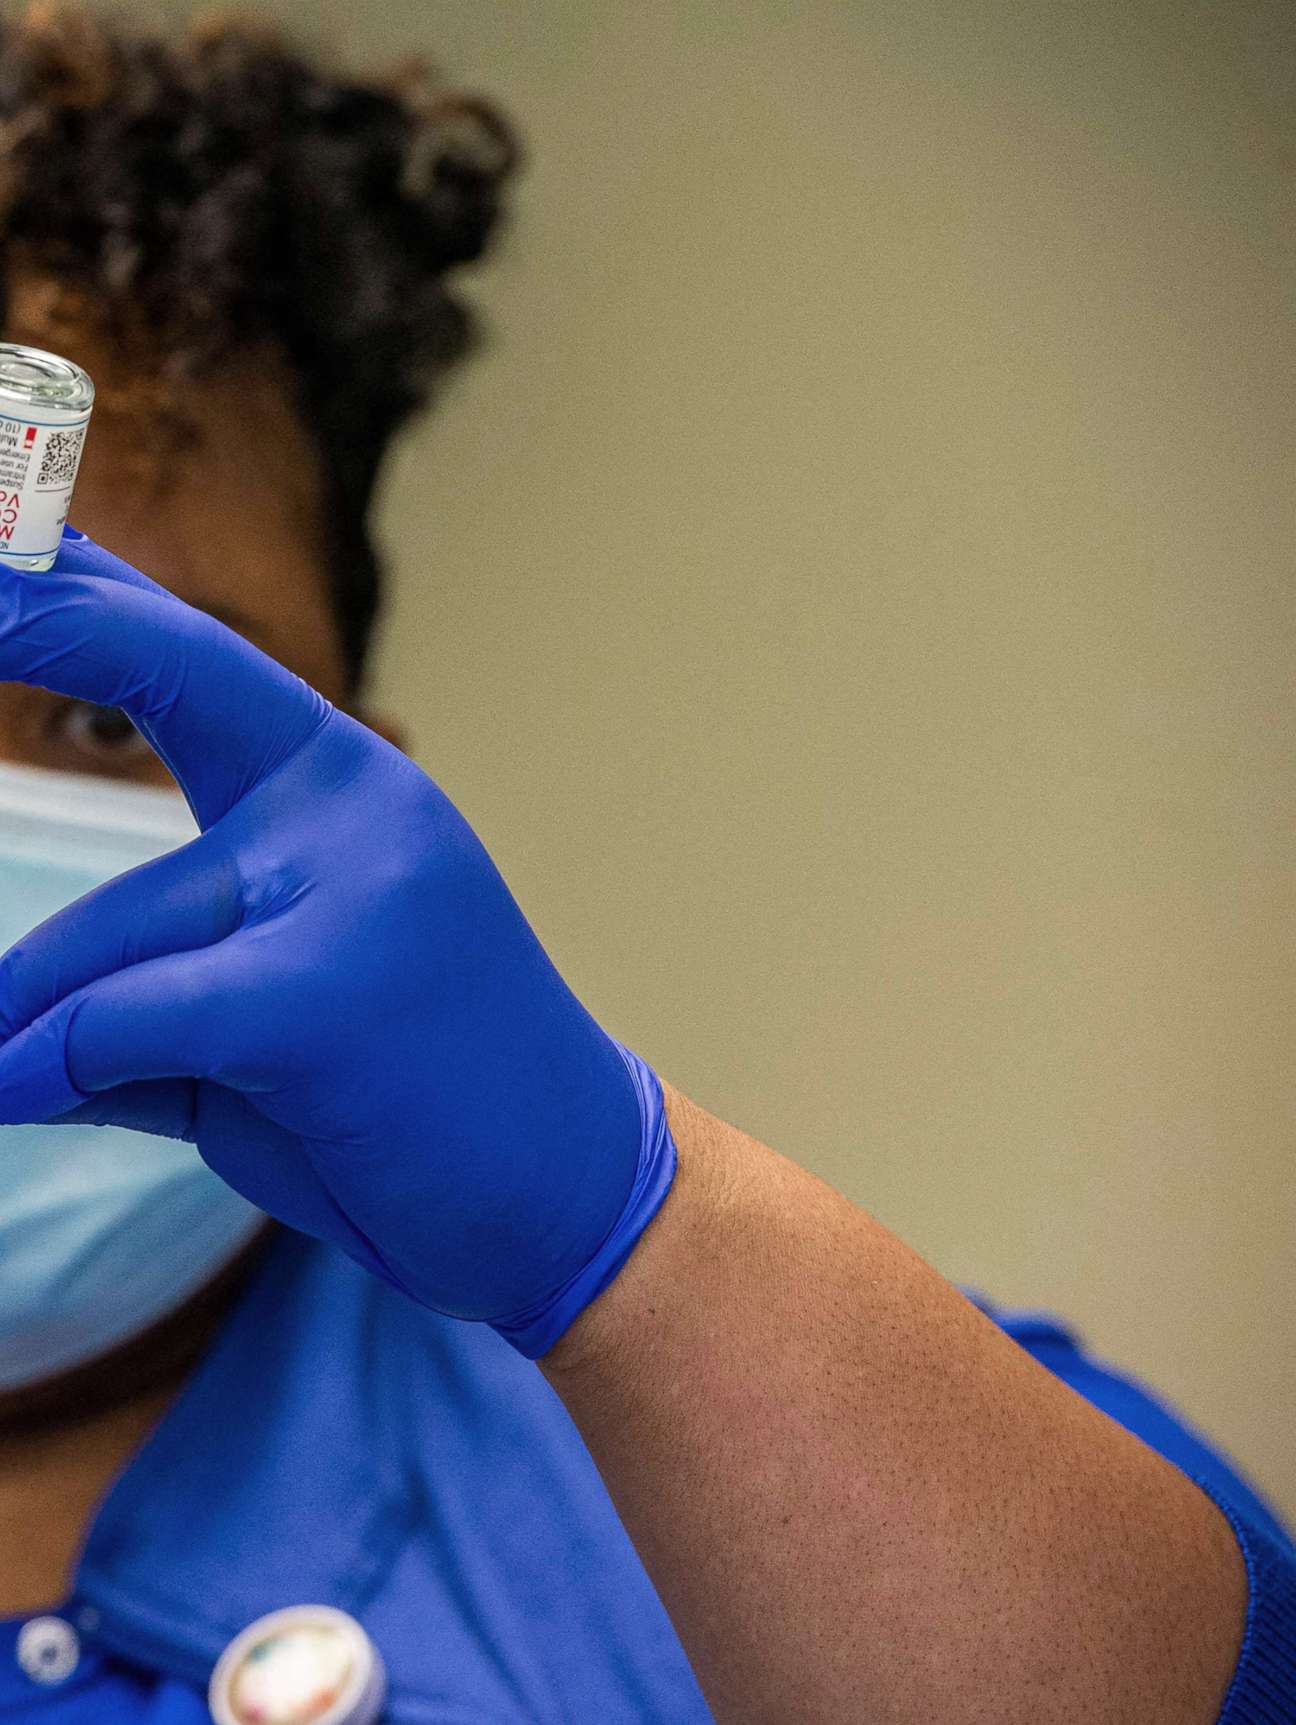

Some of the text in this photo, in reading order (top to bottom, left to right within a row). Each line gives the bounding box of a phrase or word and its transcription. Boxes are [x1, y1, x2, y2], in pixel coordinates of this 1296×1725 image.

[4, 422, 21, 434] (10
[0, 459, 14, 467] use
[16, 464, 29, 472] For
